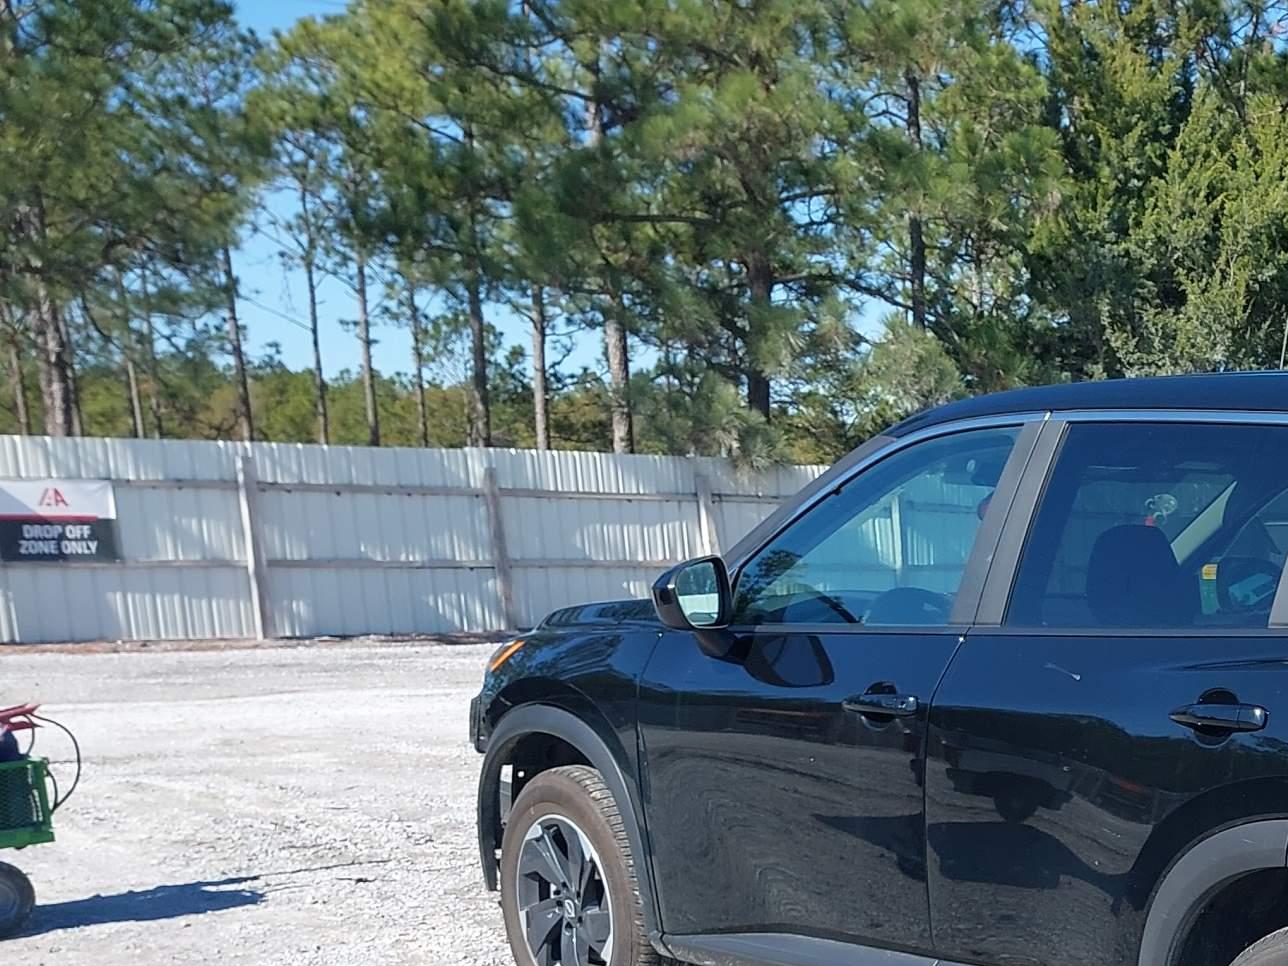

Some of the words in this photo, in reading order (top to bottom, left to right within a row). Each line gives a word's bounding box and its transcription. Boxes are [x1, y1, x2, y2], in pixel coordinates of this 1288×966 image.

[22, 525, 62, 539] DROP
[65, 525, 91, 539] OFF
[19, 540, 59, 554] ZONE
[61, 540, 98, 554] ONLY
